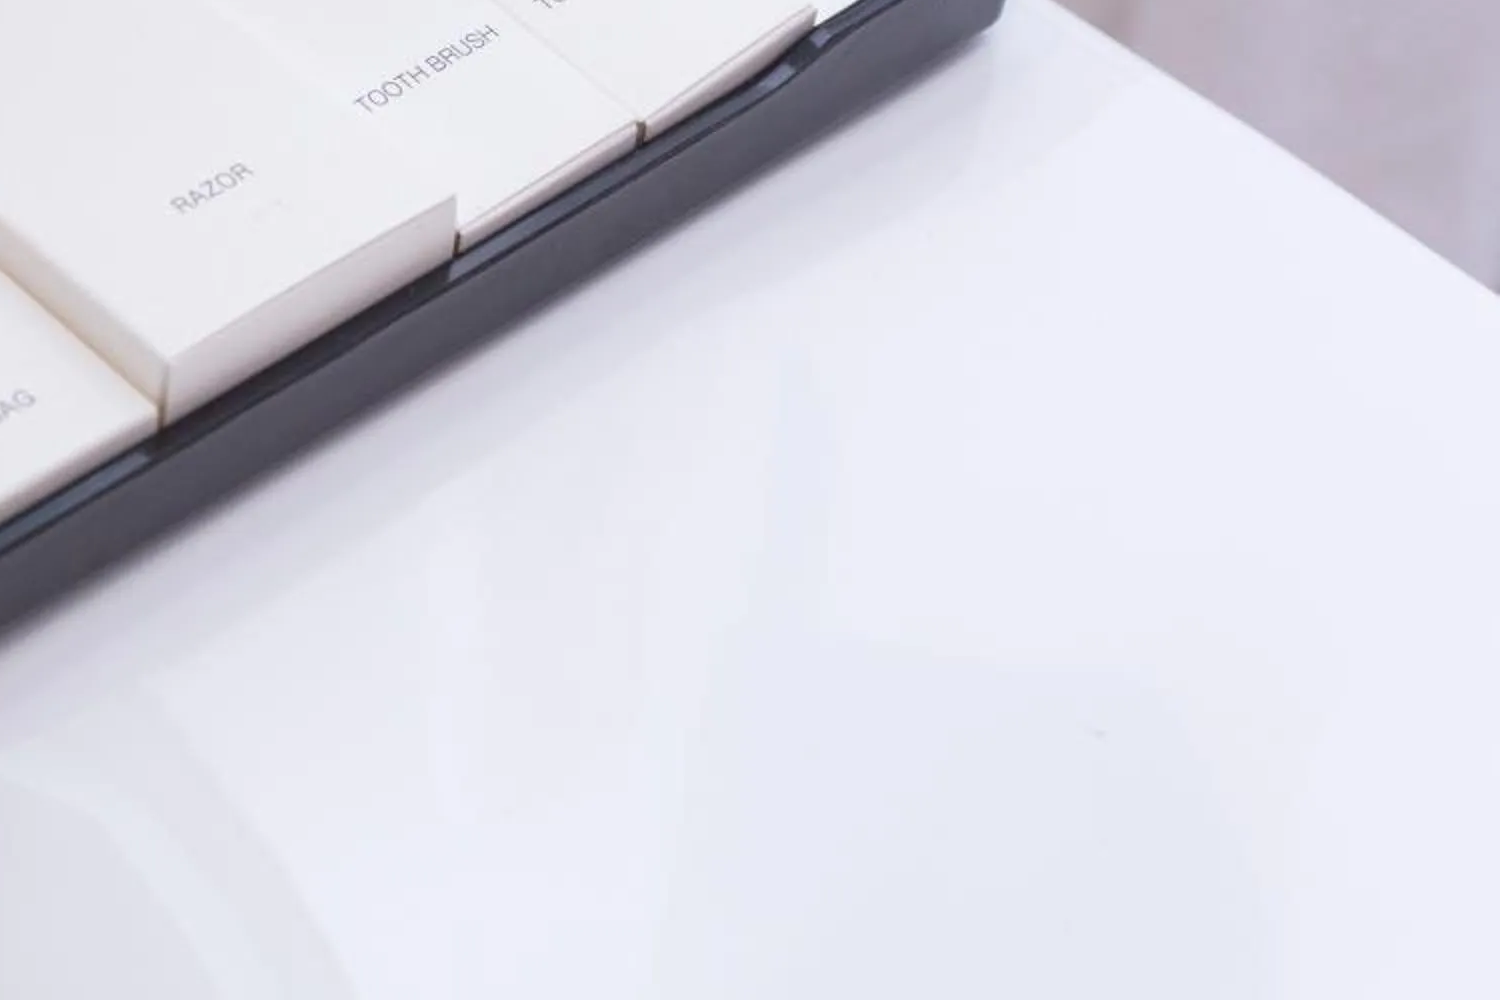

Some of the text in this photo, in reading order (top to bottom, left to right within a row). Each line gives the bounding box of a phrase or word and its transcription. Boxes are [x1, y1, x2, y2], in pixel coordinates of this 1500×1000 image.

[353, 24, 500, 113] TOOTH BRUSH
[169, 162, 254, 215] RAZOR
